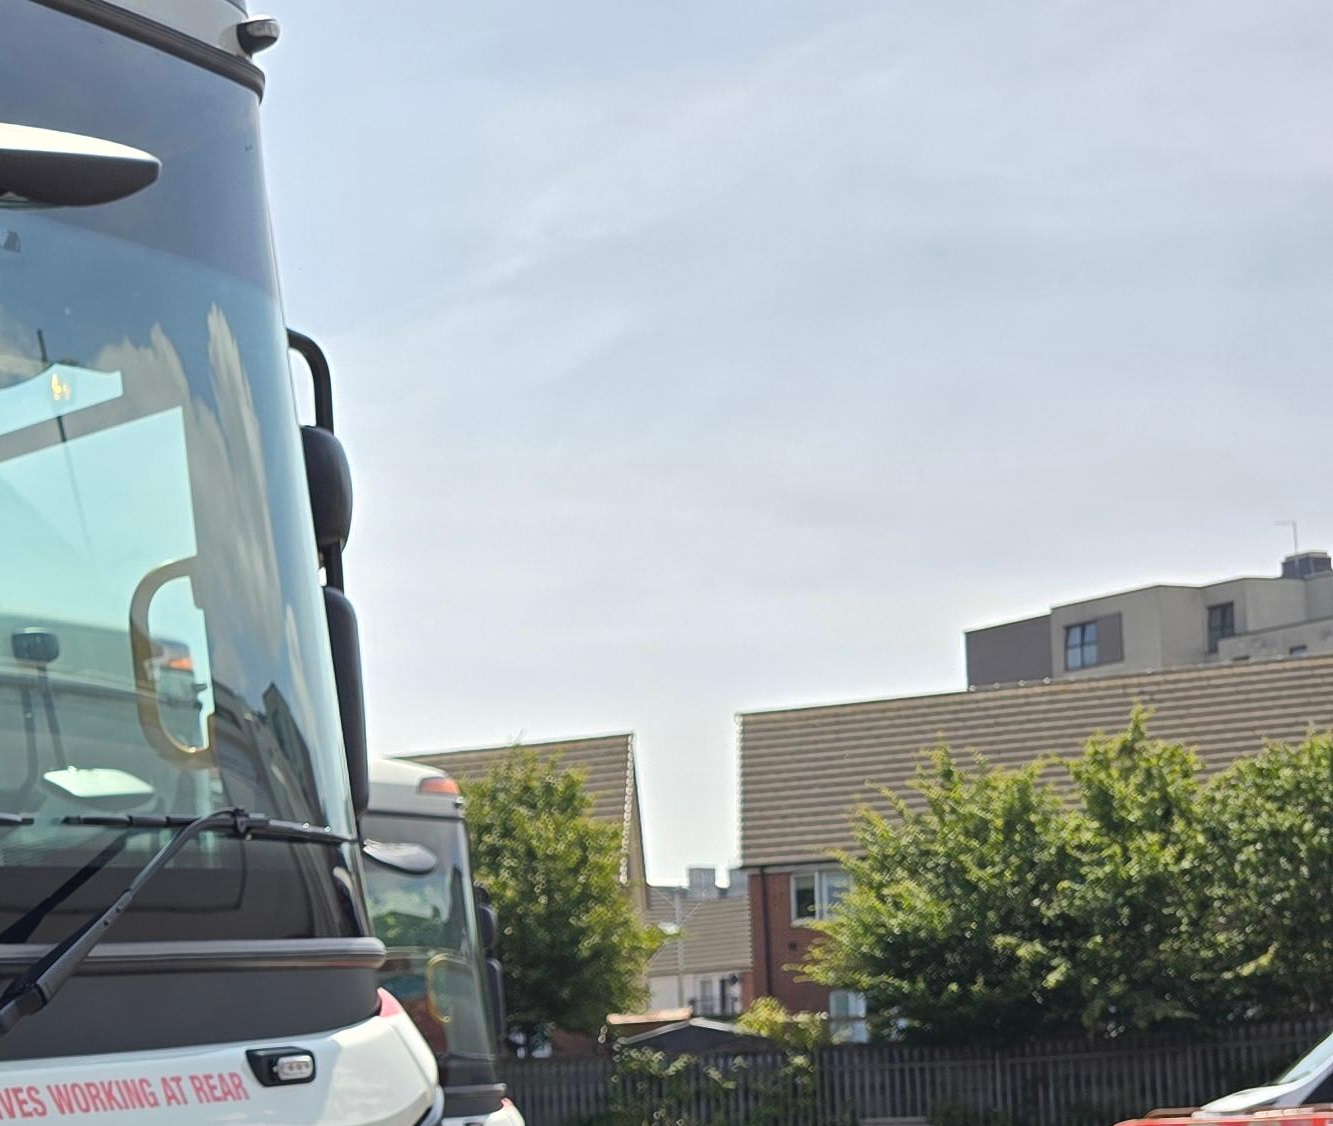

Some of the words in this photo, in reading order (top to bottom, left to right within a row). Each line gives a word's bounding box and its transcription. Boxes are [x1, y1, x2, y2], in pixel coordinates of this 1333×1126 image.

[46, 1078, 160, 1114] WORKING
[159, 1075, 189, 1105] AT
[193, 1072, 250, 1103] REAR
